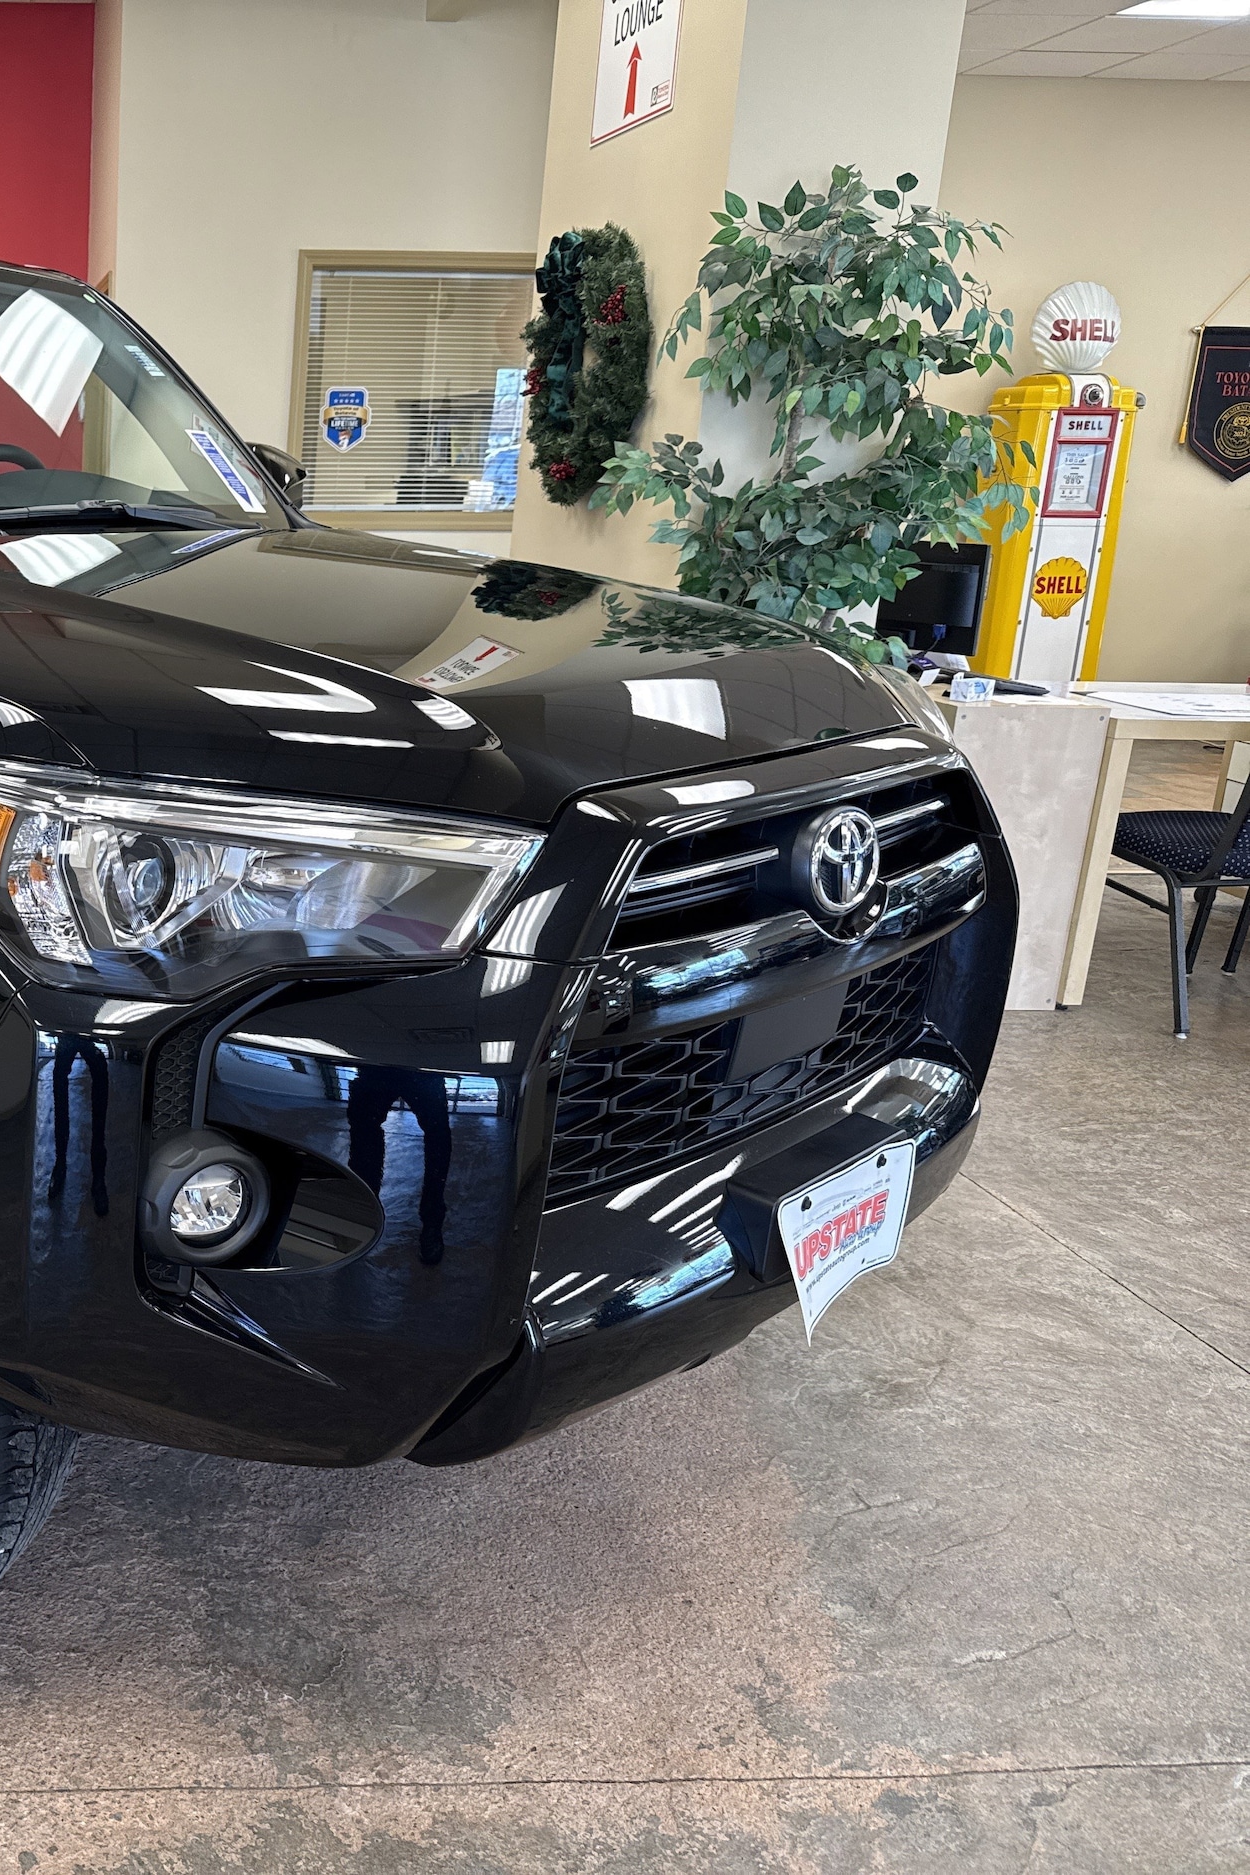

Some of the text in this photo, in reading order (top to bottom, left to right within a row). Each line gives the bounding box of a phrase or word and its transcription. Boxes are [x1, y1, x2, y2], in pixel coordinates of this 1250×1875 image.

[614, 0, 664, 47] LOUNGE
[1068, 420, 1103, 431] SHELL
[1035, 576, 1083, 595] SHELL
[794, 1189, 889, 1281] UPSTATE
